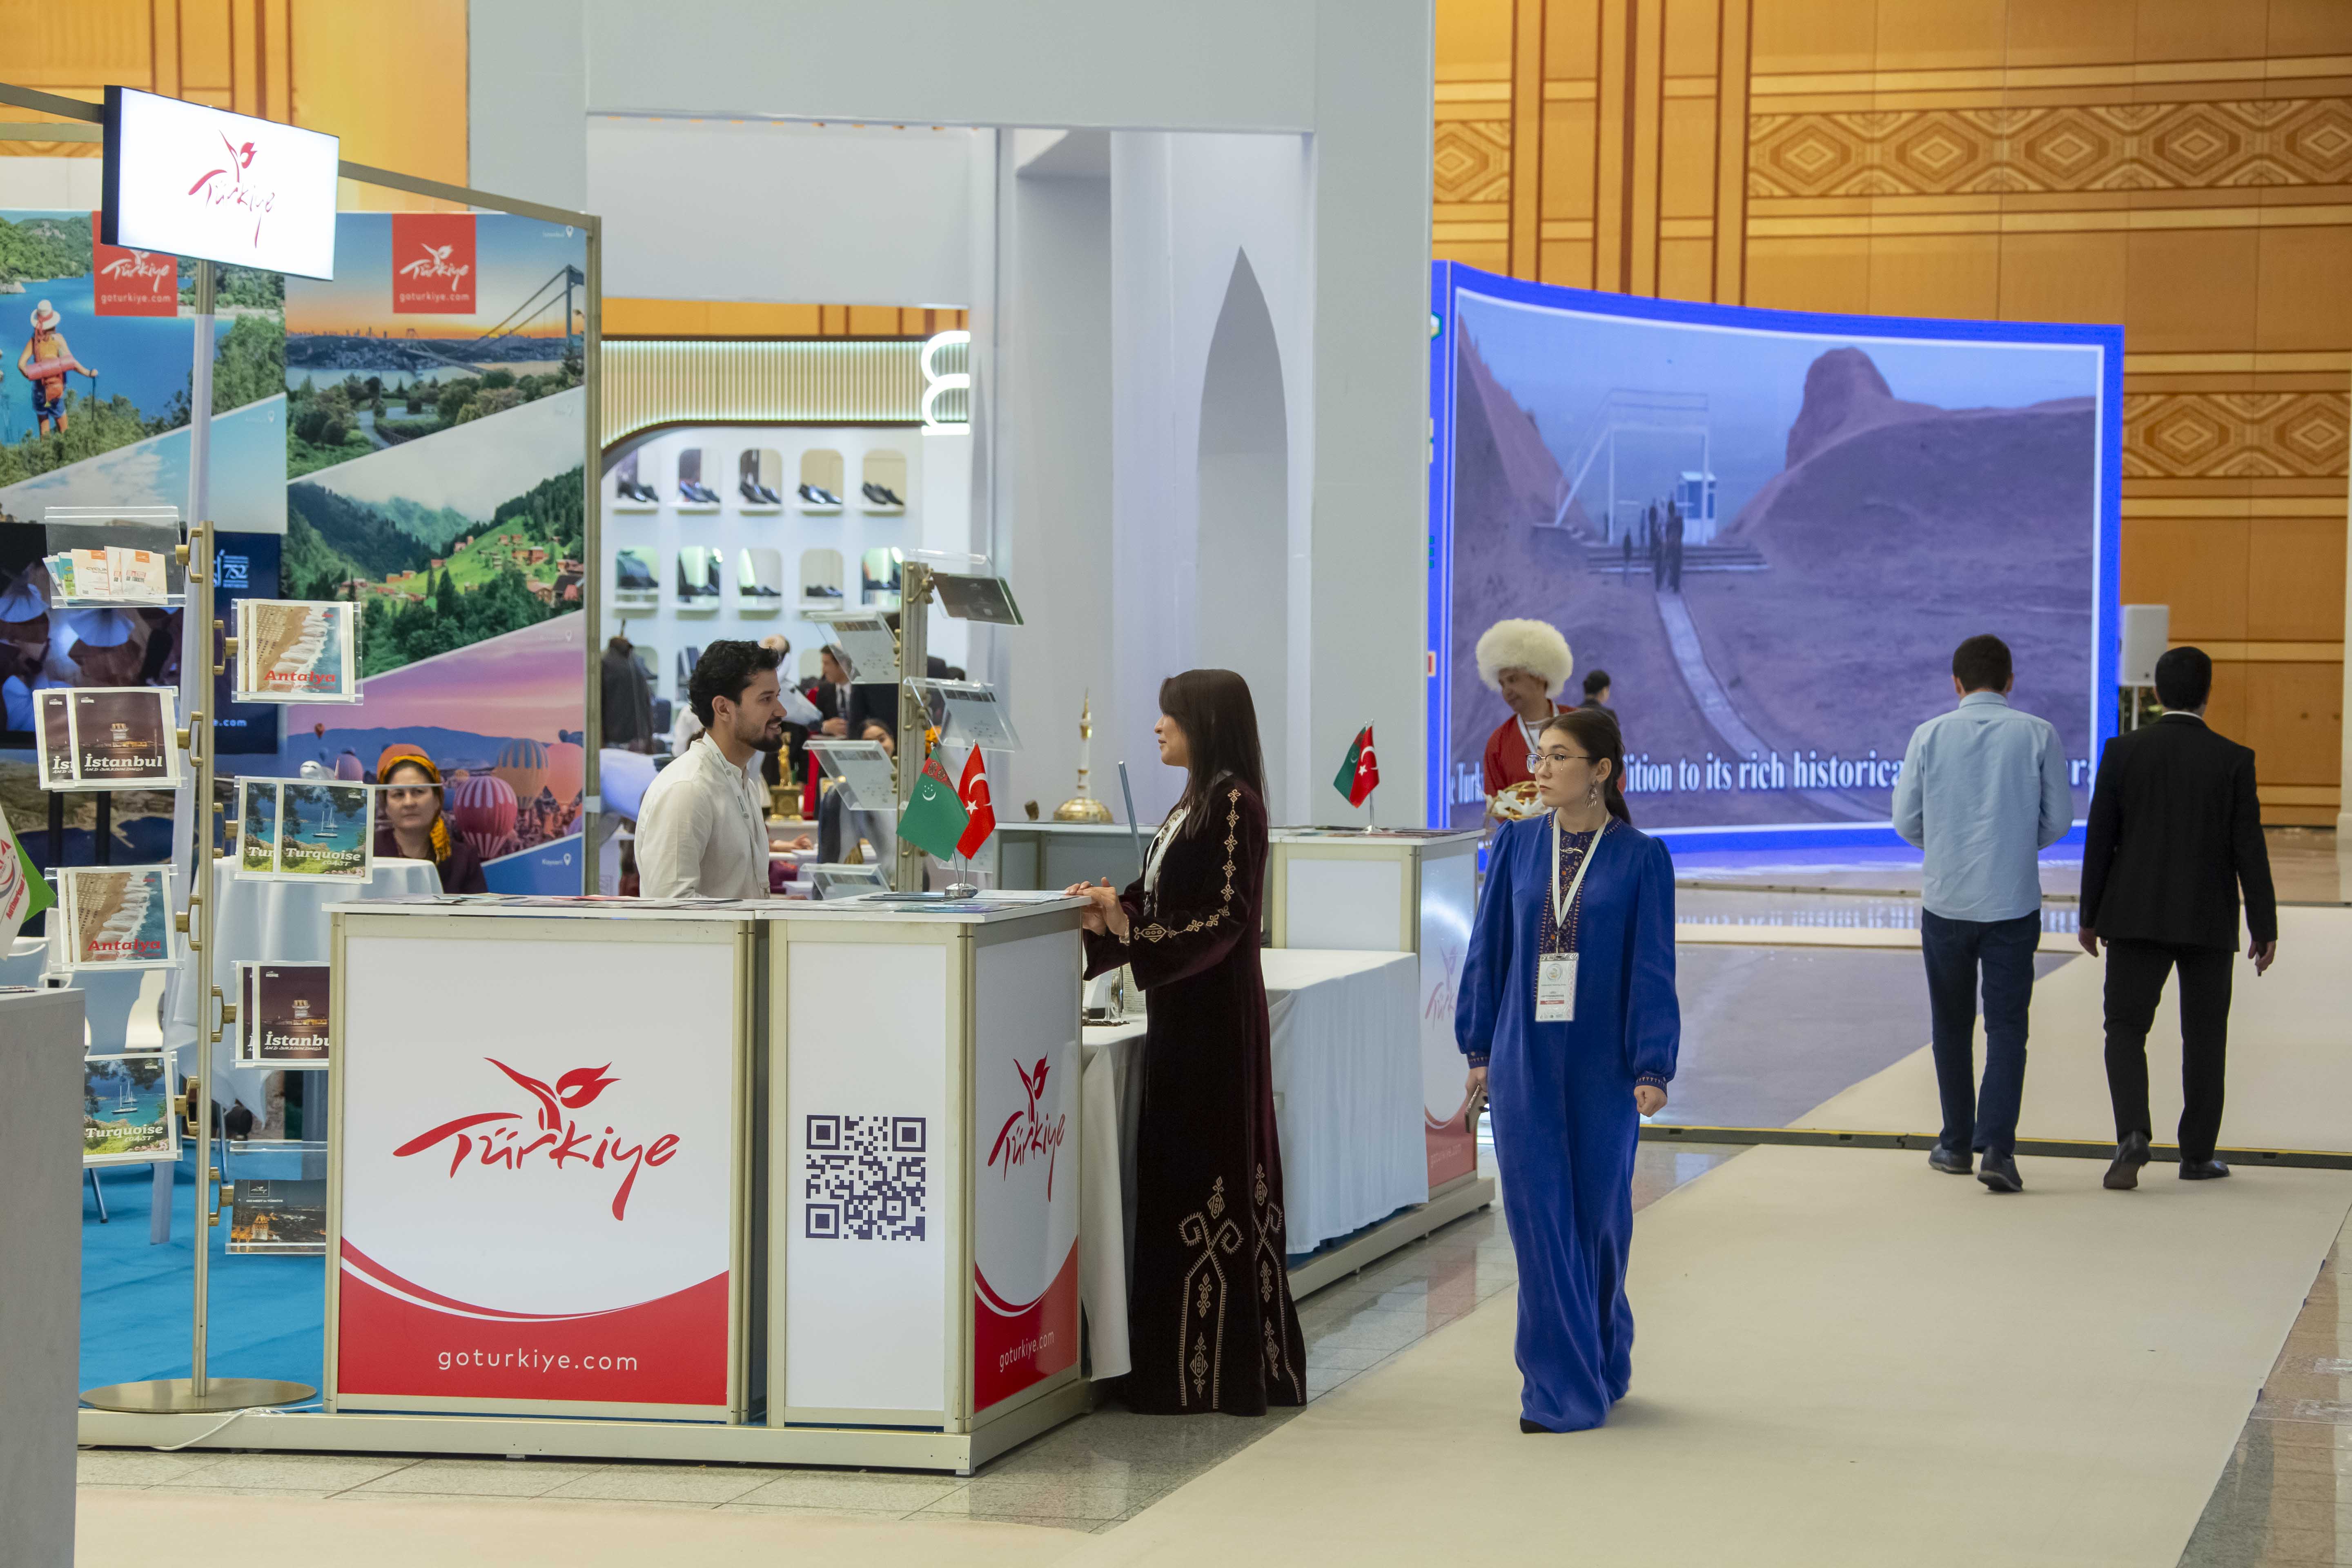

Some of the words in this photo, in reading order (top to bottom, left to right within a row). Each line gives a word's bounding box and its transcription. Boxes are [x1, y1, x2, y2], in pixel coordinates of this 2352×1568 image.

[188, 169, 275, 248] Türkiye
[101, 258, 170, 293] Türkiye
[400, 258, 469, 292] Türkiye
[101, 292, 172, 304] goturkiye.com
[399, 291, 470, 303] goturkiye.com
[264, 670, 336, 684] Antalya
[84, 753, 163, 767] İstanbul
[1679, 756, 1700, 792] to
[1706, 751, 1732, 791] its
[1739, 751, 1785, 790] rich
[286, 848, 361, 861] Turquoise
[87, 938, 161, 952] Antalya
[85, 1124, 163, 1138] Turquoise
[393, 1112, 680, 1221] Türkiye
[987, 1111, 1065, 1203] Türkiye
[438, 1348, 638, 1372] goturkiye.com
[1000, 1330, 1054, 1373] goturkiye.com
